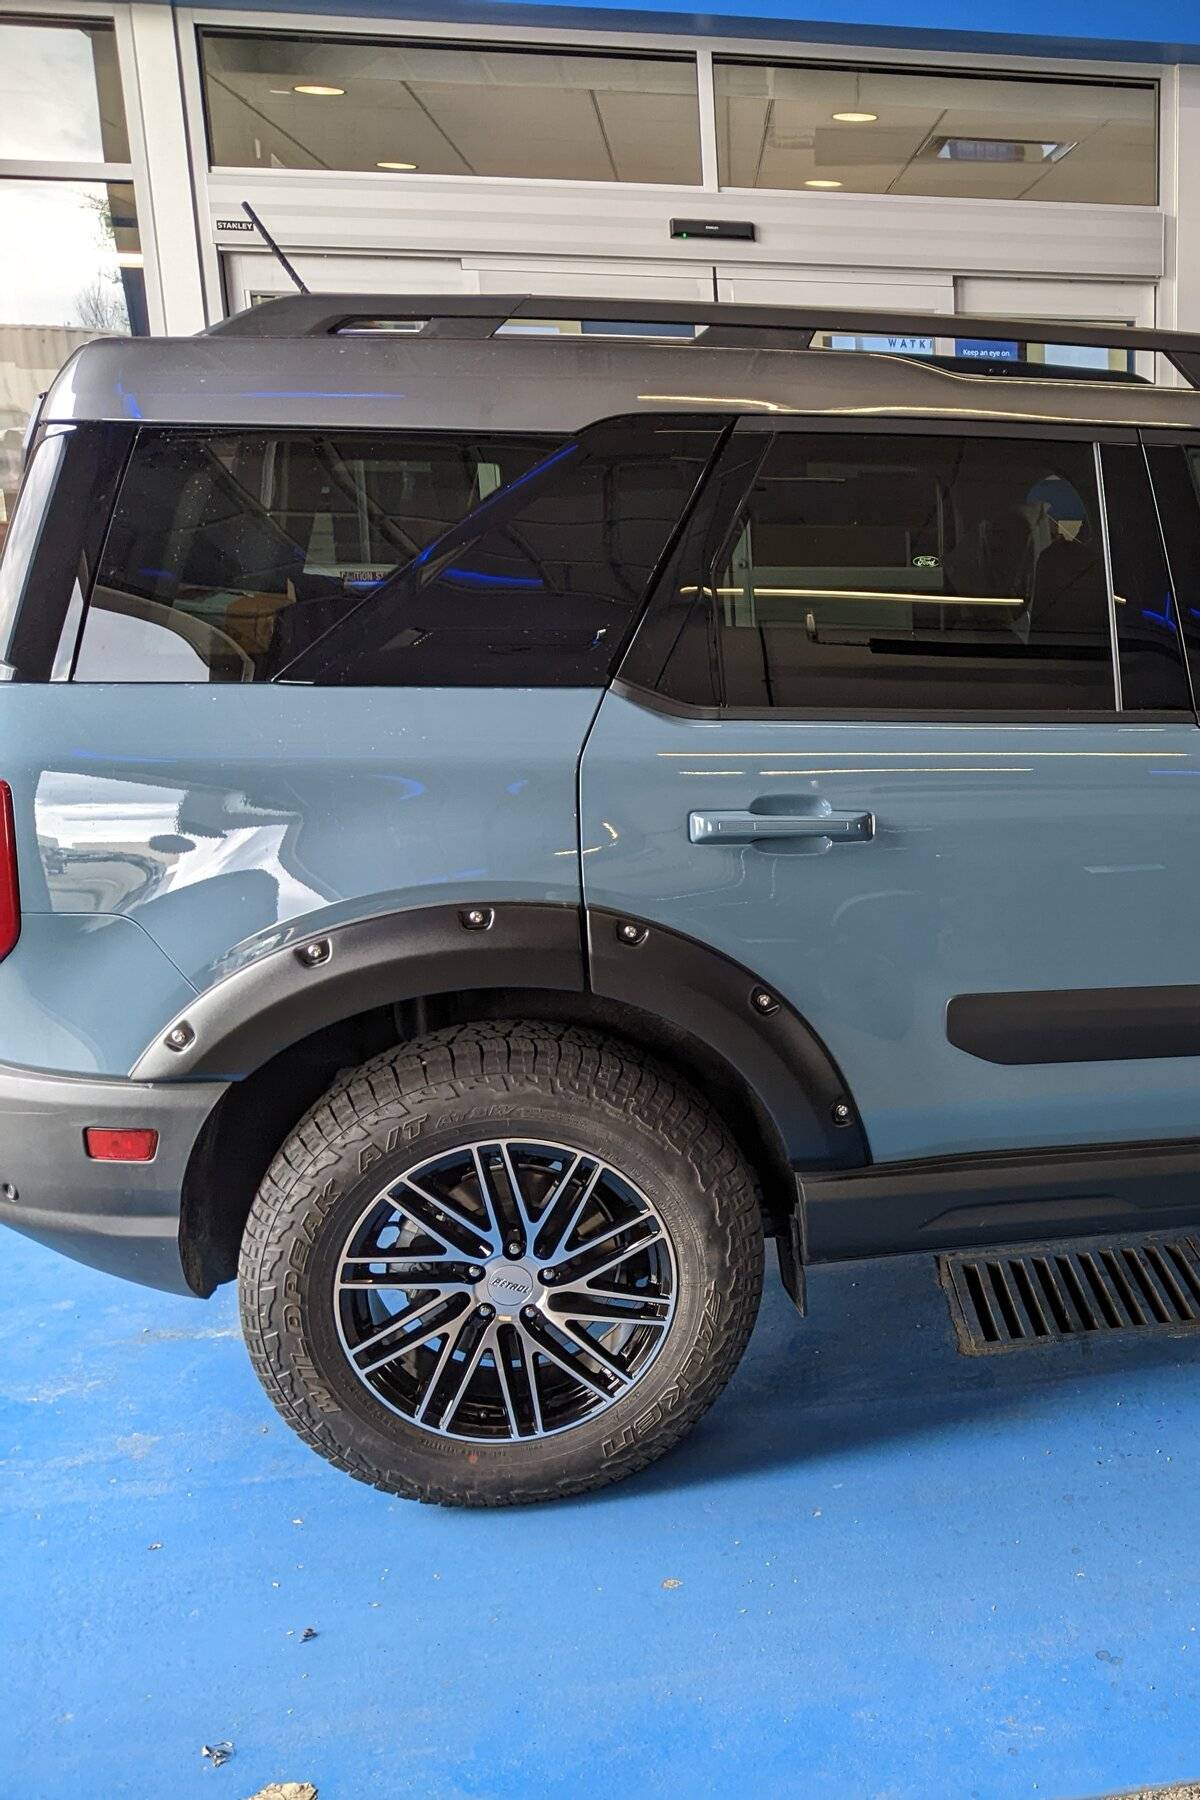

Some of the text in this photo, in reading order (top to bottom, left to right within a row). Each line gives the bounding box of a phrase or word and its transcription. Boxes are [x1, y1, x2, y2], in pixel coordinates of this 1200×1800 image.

[217, 222, 252, 230] STANLEY
[963, 349, 979, 357] Keep
[491, 1277, 530, 1293] PETROL
[282, 1178, 341, 1412] WILDPEAK
